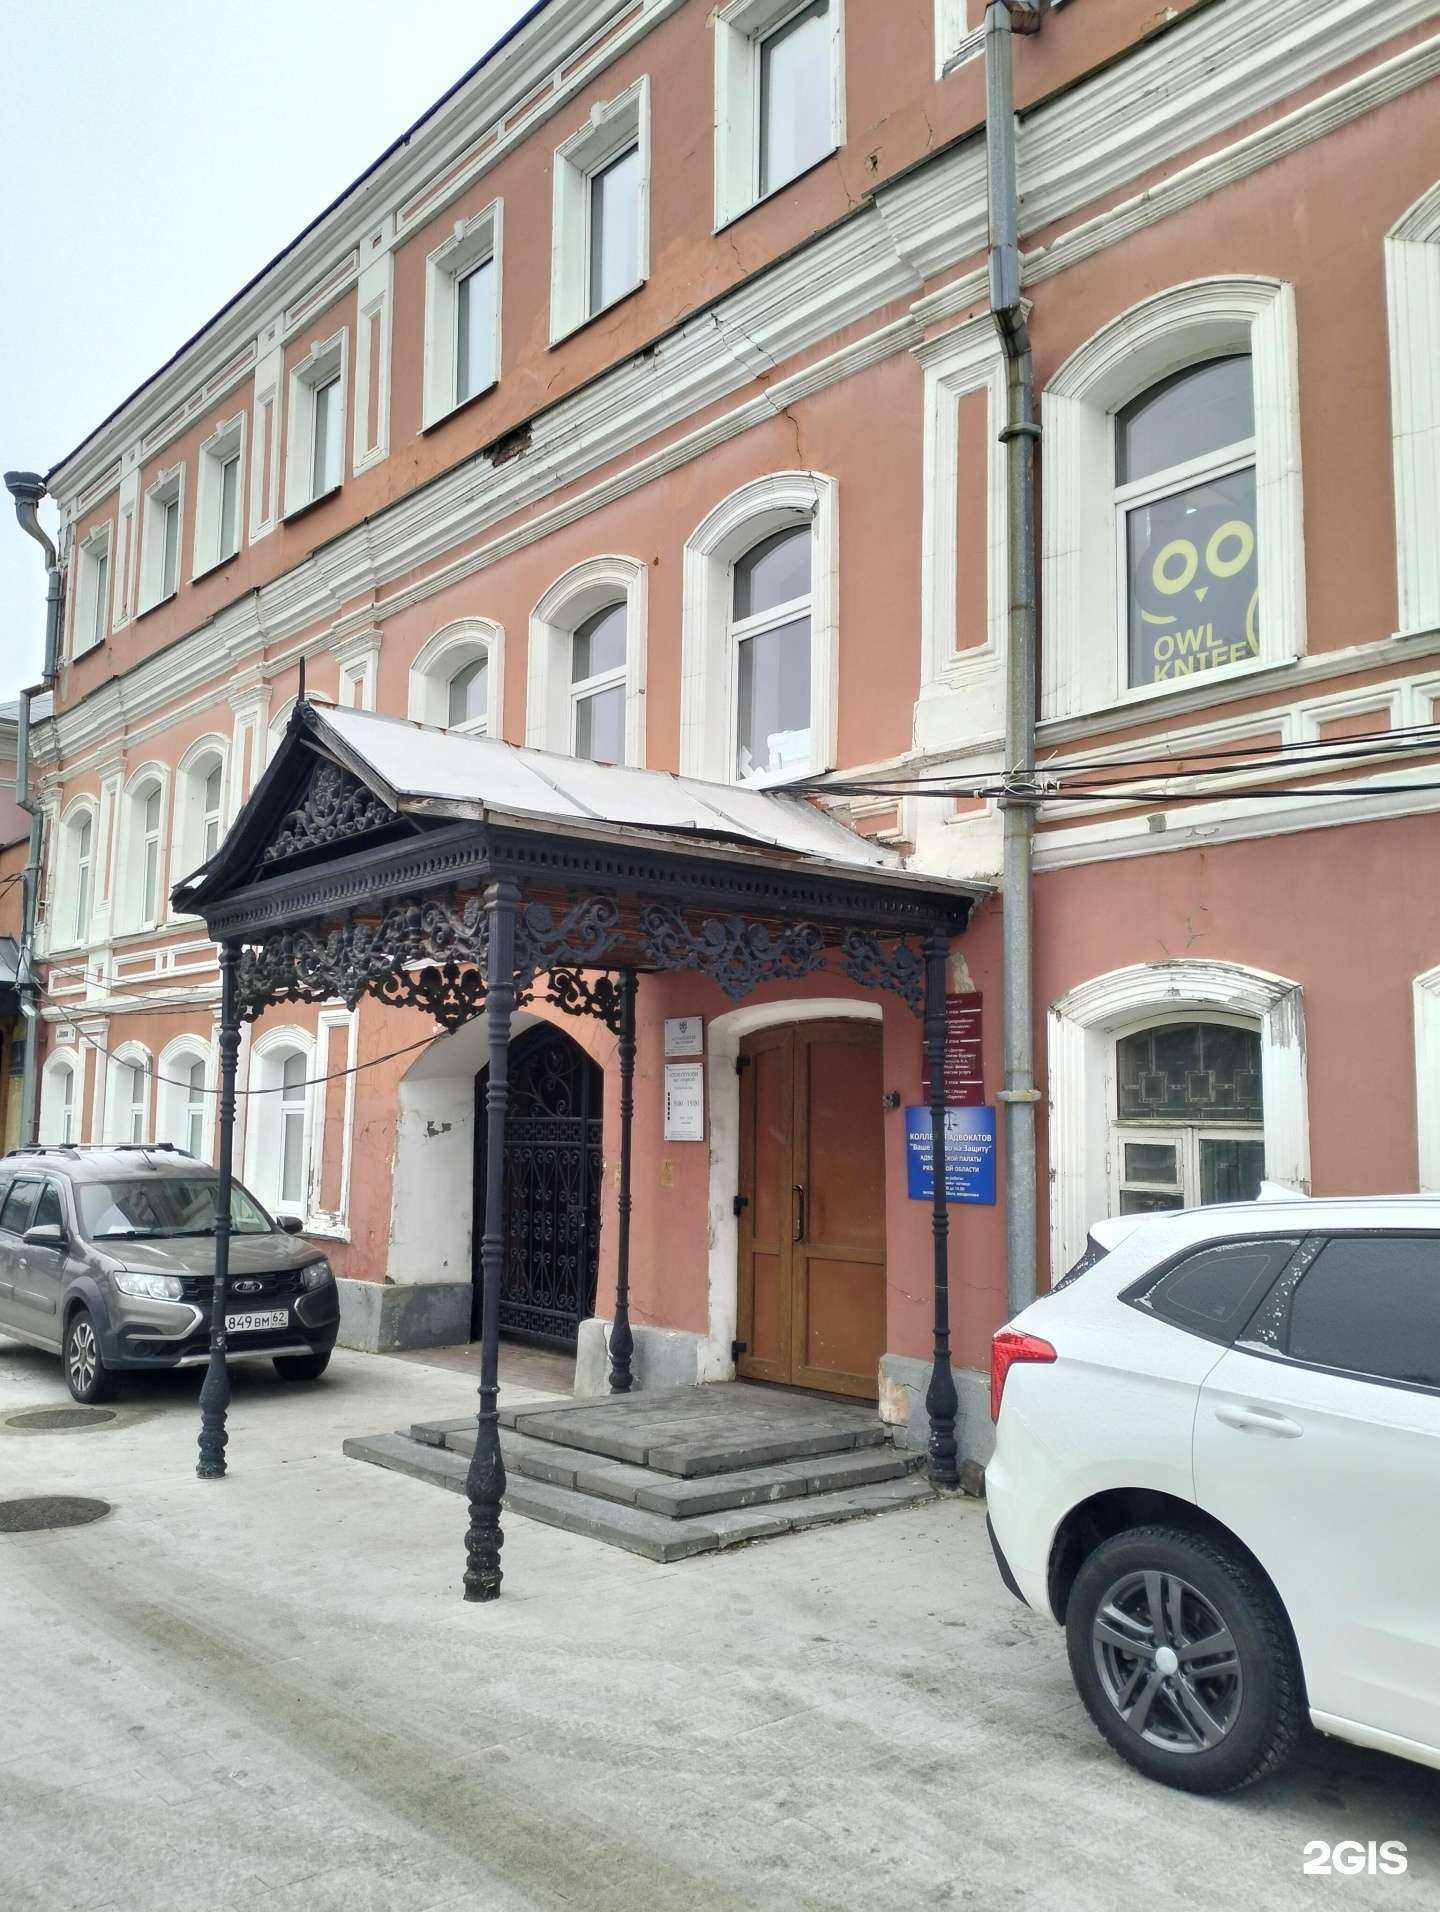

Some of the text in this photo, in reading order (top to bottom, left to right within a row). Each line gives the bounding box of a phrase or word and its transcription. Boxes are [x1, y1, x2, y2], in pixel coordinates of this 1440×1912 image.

[1153, 622, 1223, 661] OWL
[949, 1134, 992, 1142] АДВОКАТОВ
[228, 1315, 270, 1330] 849ВМ
